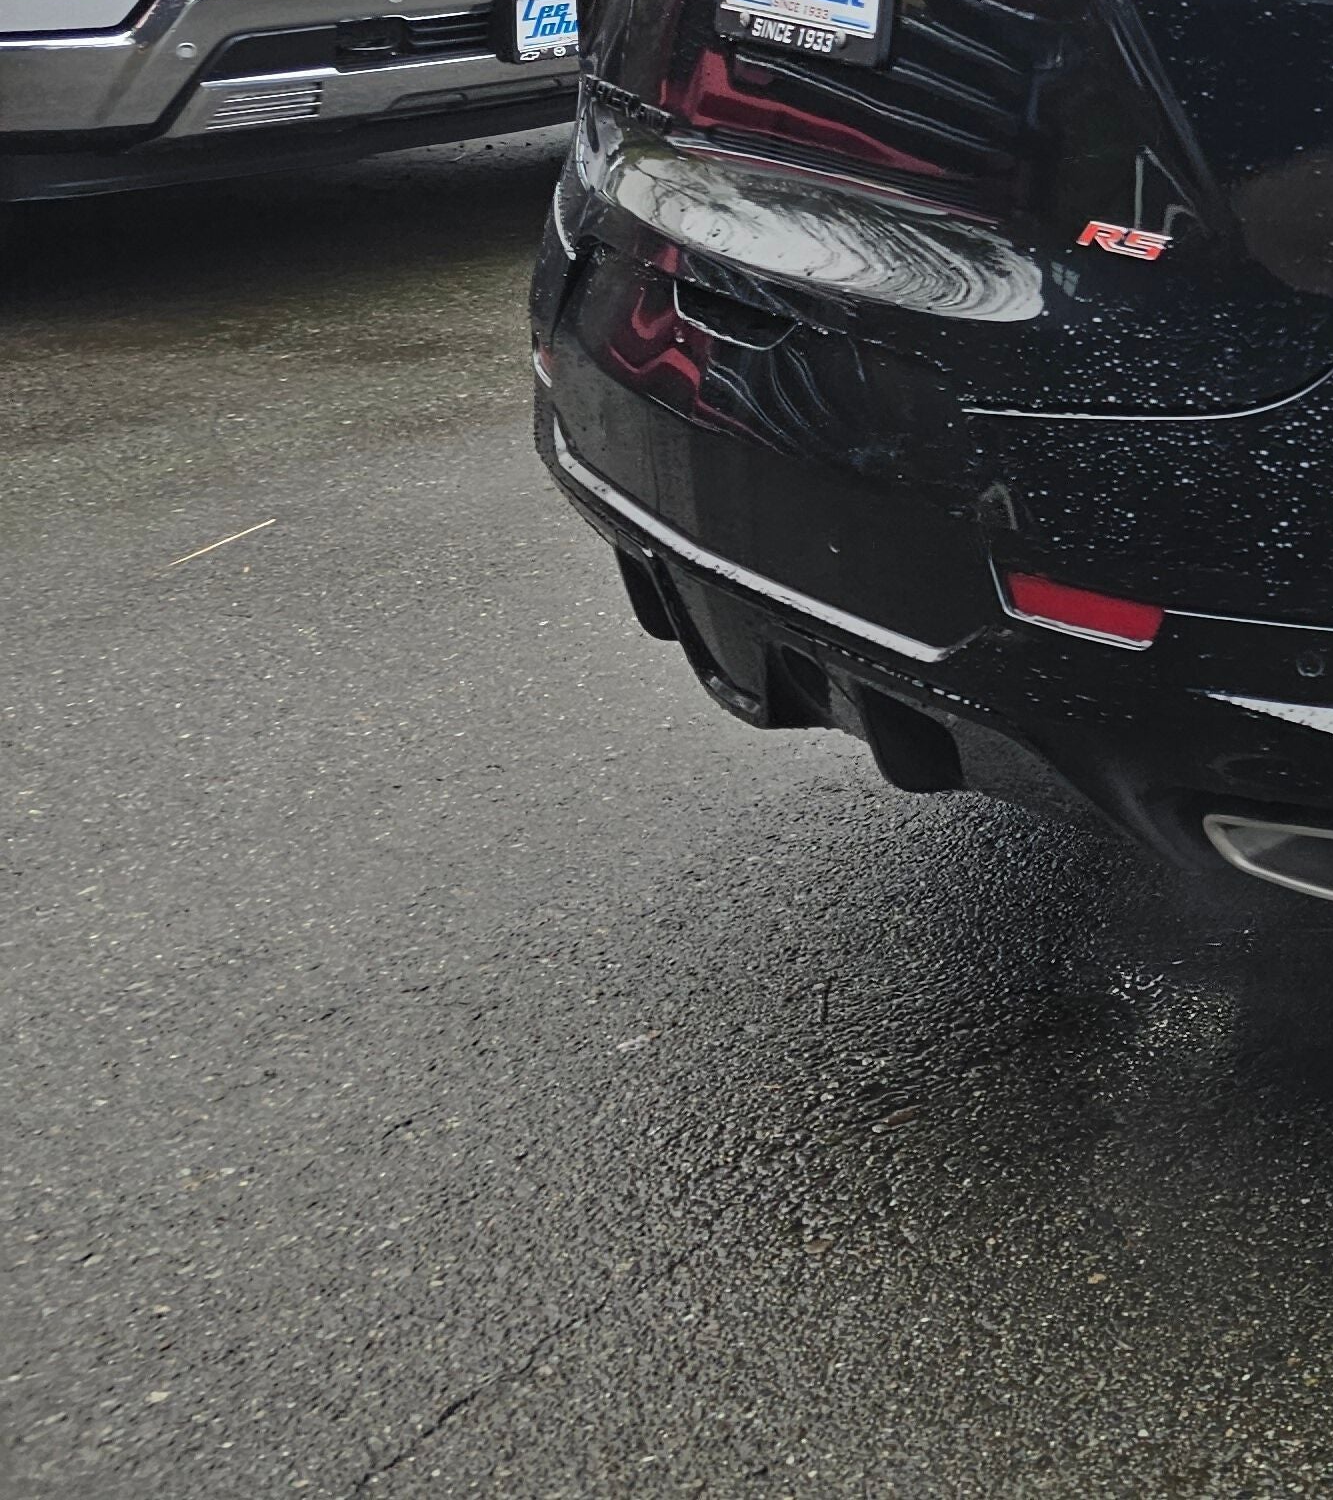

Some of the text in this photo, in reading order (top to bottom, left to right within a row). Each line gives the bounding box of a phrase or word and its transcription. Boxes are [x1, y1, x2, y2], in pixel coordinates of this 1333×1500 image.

[802, 5, 829, 20] 1933
[751, 18, 835, 53] SINCE 1933
[1075, 220, 1174, 261] RS
